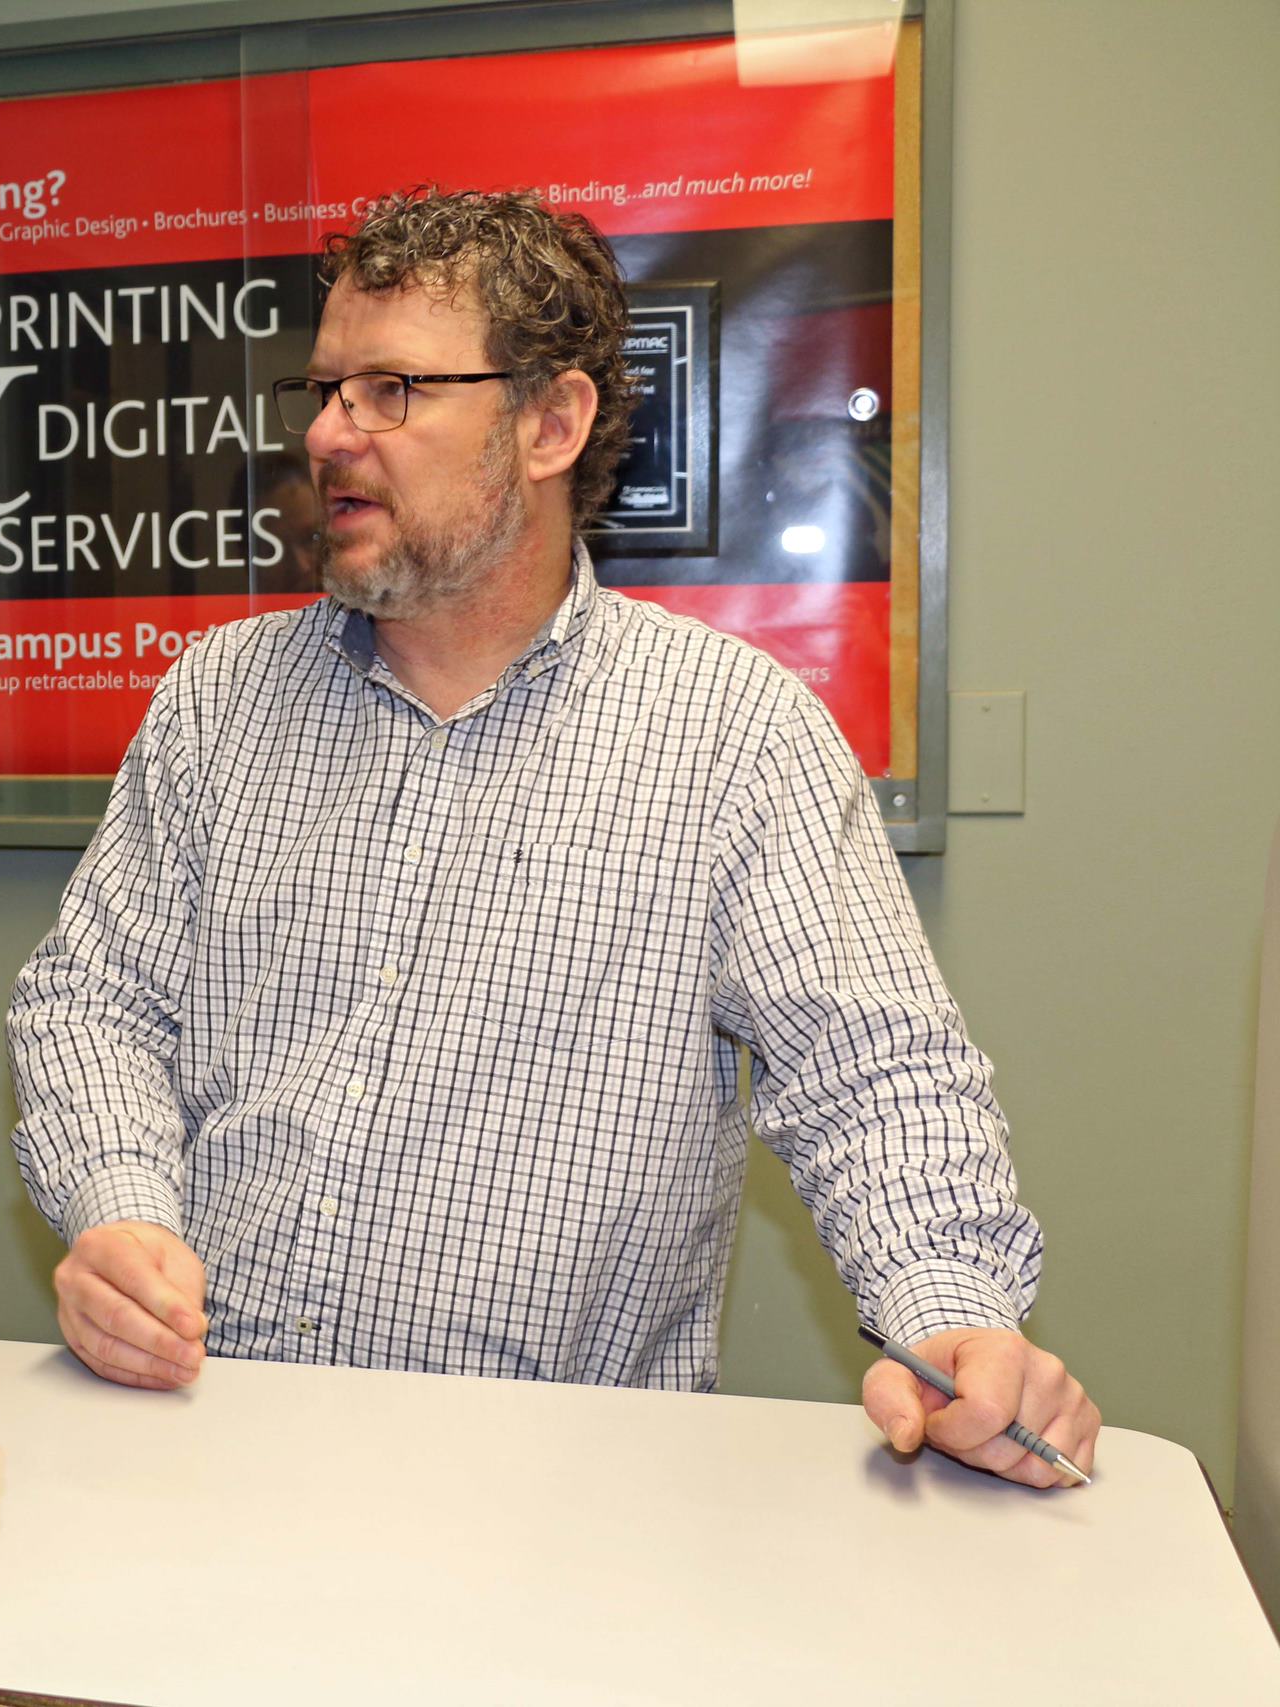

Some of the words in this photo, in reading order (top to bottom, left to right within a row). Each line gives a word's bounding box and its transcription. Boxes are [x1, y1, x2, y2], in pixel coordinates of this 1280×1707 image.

[0, 217, 70, 245] Graphic
[75, 214, 138, 239] Design
[154, 208, 248, 231] Brochures
[264, 201, 347, 222] Business
[685, 171, 745, 196] much
[748, 168, 813, 191] more!
[37, 393, 284, 462] DIGITAL
[134, 622, 217, 659] Pos
[24, 669, 124, 691] retractable
